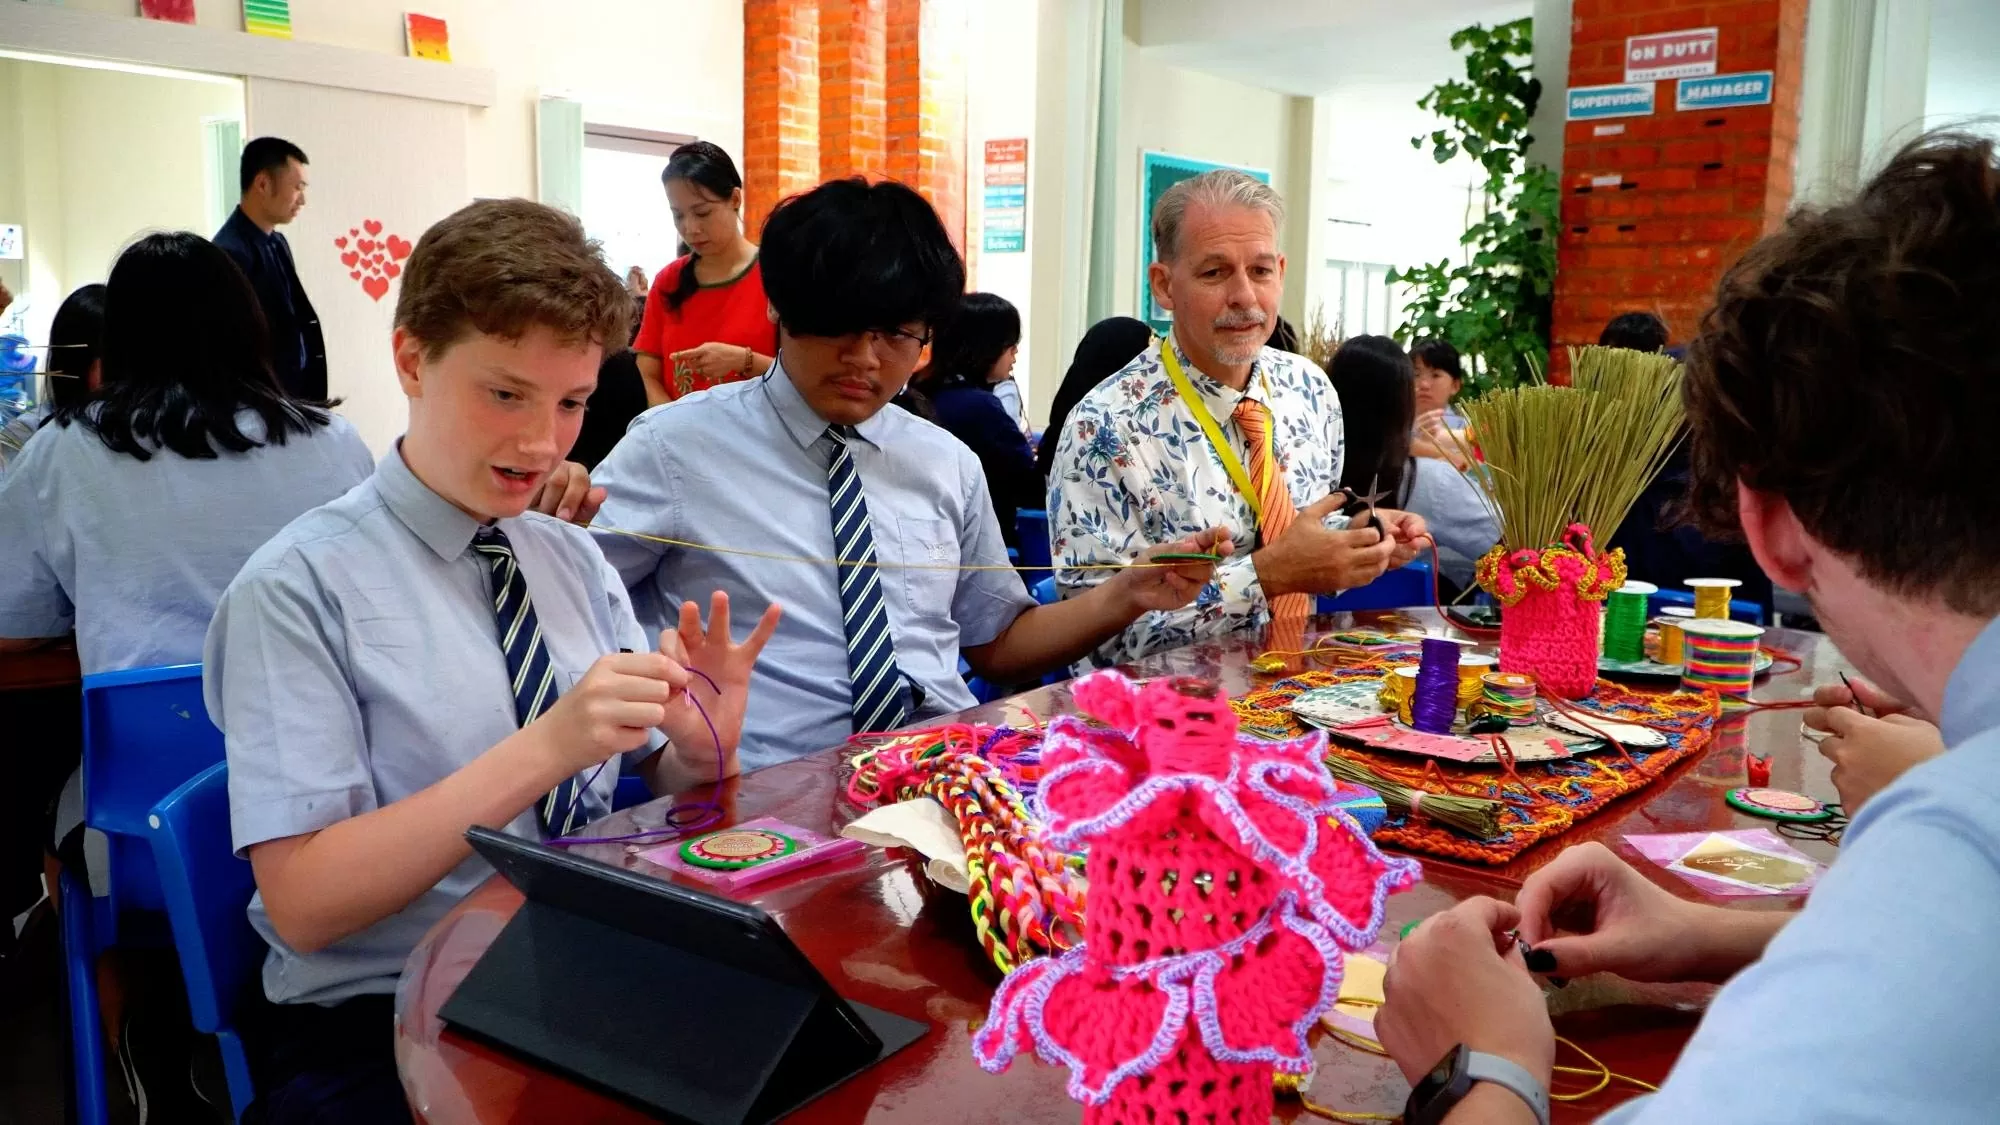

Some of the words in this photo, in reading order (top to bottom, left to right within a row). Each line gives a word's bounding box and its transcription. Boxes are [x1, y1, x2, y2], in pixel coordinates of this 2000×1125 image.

[1631, 45, 1657, 61] ON
[1663, 40, 1712, 58] DUTY
[1686, 81, 1763, 99] MANAGER
[1571, 92, 1649, 109] SUPERVISOR
